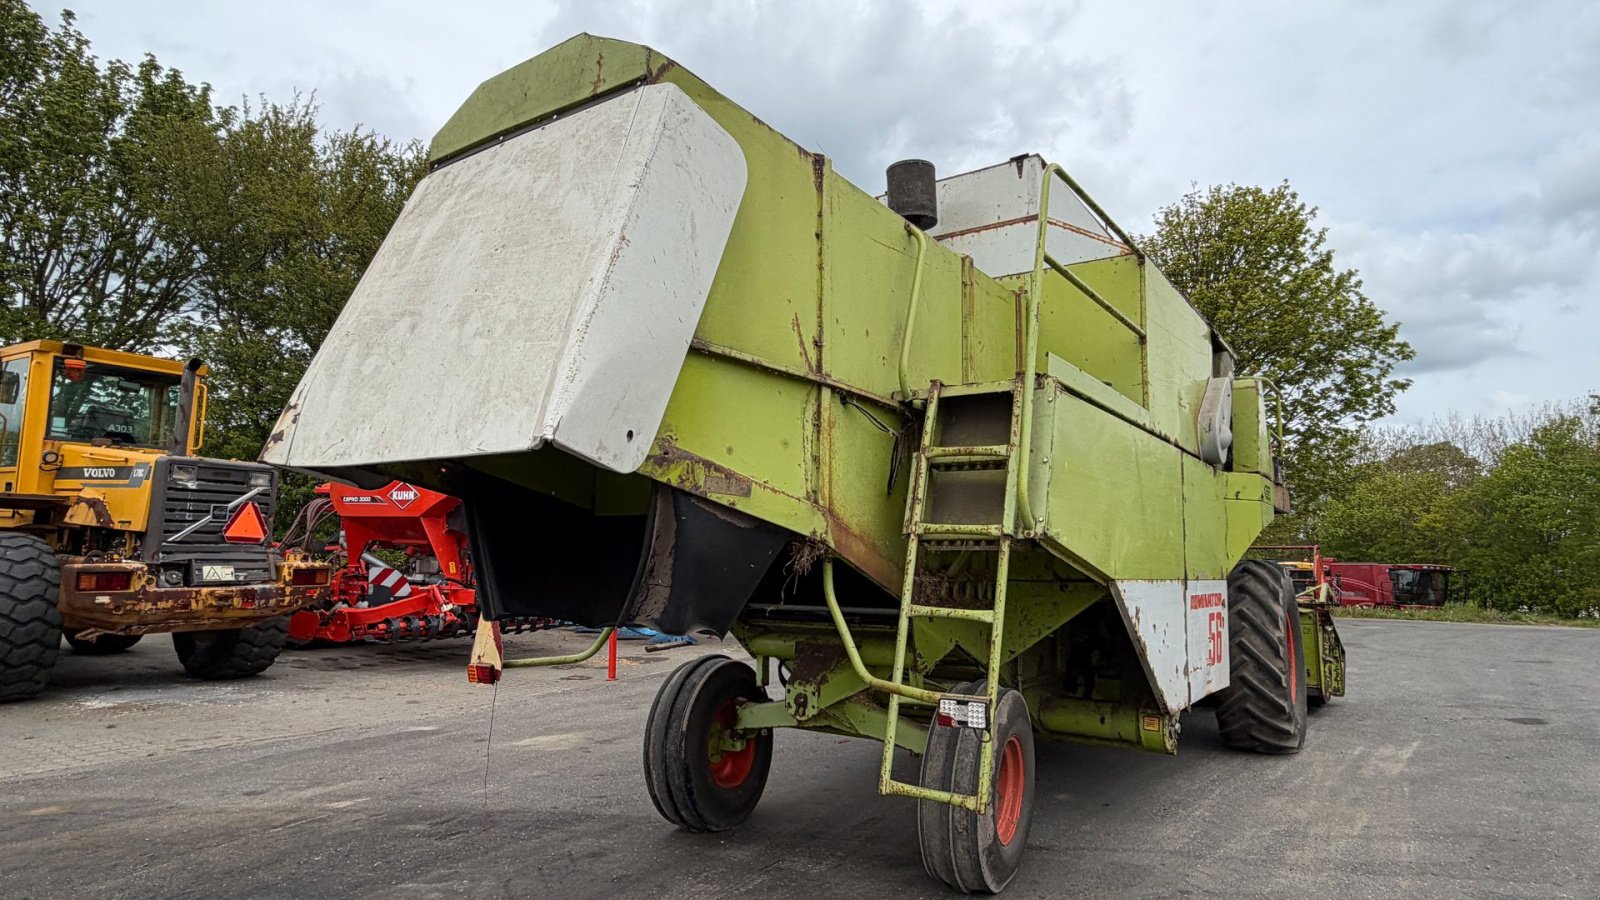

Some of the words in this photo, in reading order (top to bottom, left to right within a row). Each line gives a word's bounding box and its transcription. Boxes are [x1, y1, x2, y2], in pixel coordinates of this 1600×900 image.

[107, 424, 133, 434] A303
[83, 468, 115, 478] VOLVO
[392, 490, 415, 500] KUHN
[1190, 593, 1222, 610] DOMINATOR
